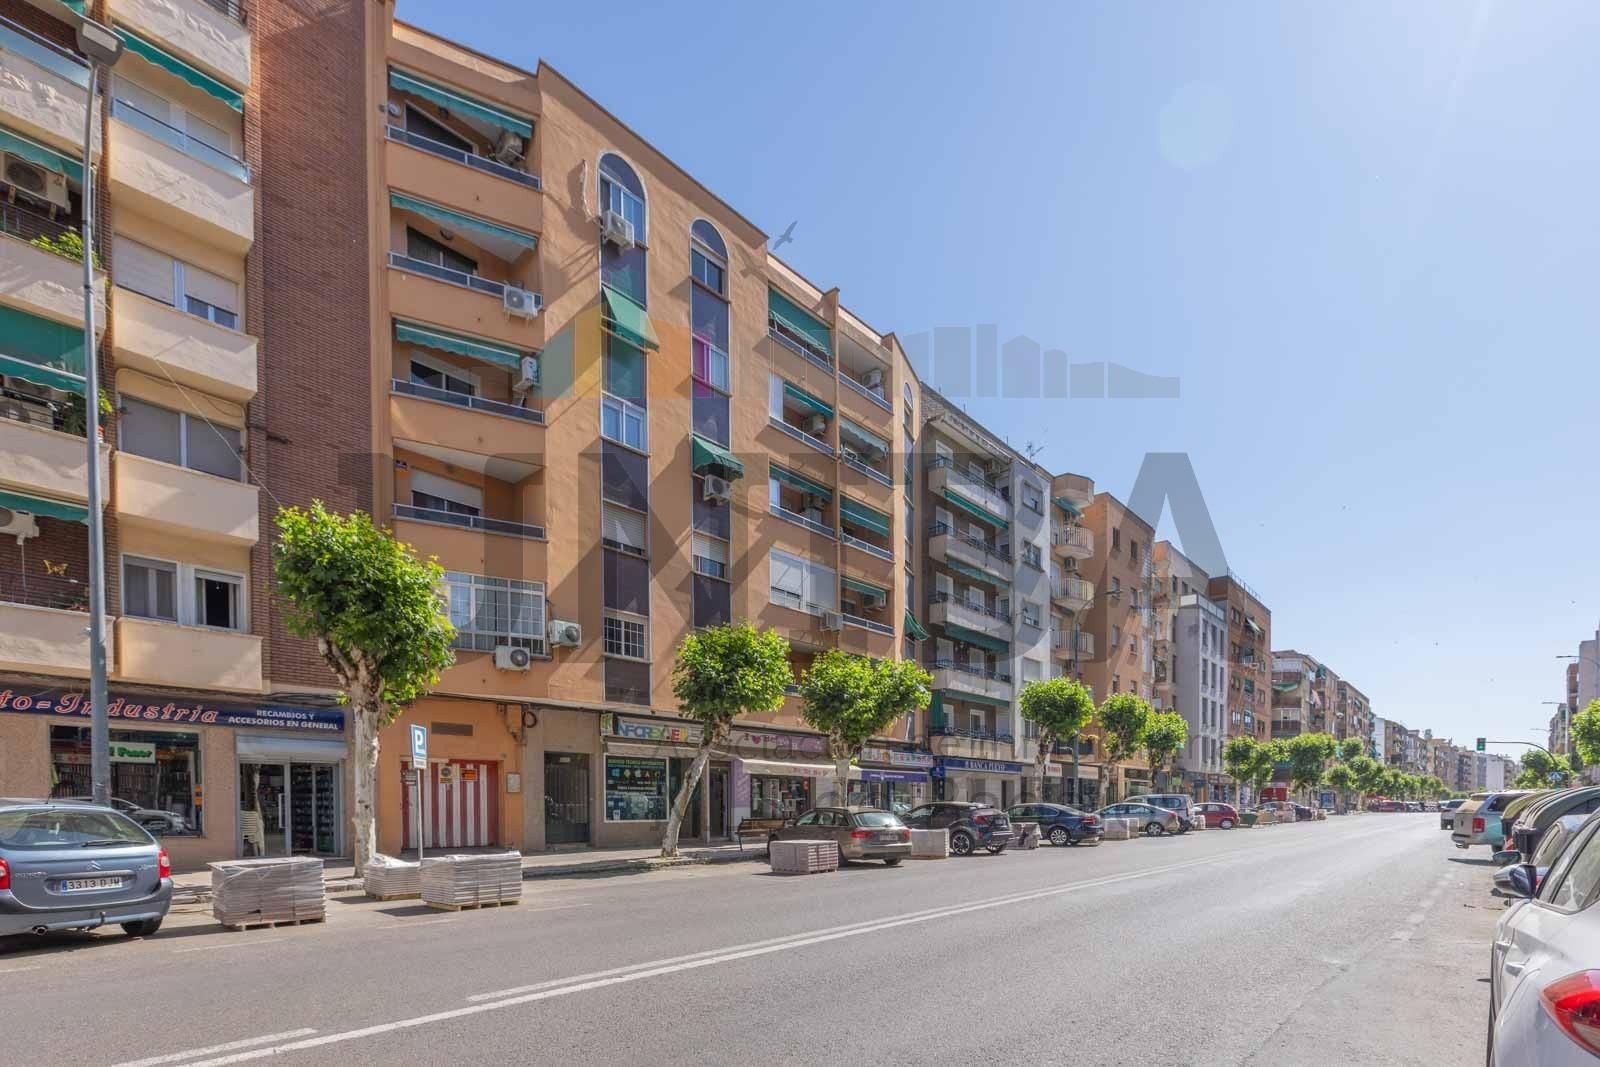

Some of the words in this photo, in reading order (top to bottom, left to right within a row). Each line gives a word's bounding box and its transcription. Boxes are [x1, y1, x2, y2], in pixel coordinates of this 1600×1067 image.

[256, 709, 307, 720] RECAMBIOS
[308, 712, 315, 720] Y
[228, 716, 285, 727] ACCESORIOS
[286, 720, 299, 728] EN
[300, 721, 339, 731] GENERAL
[414, 730, 426, 755] P
[68, 879, 97, 890] 3313
